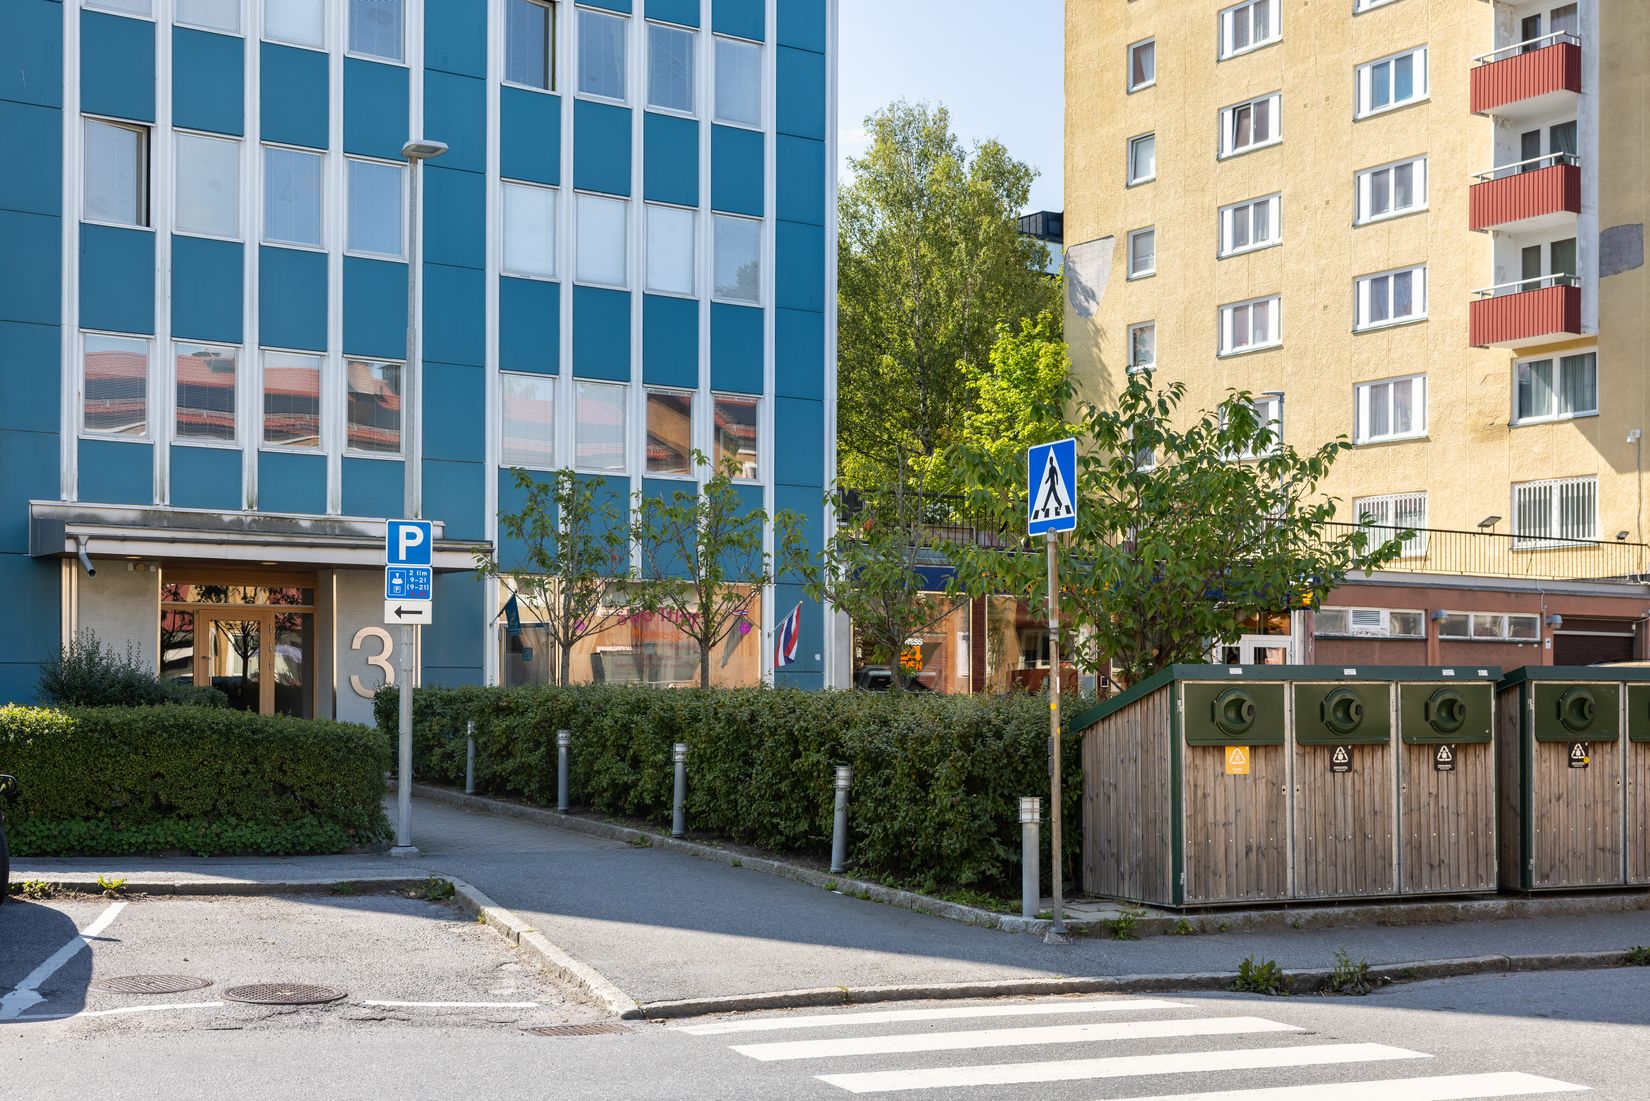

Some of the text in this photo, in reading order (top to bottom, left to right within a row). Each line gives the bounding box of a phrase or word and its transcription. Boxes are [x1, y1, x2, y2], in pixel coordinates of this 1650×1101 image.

[398, 525, 424, 560] P
[406, 583, 429, 591] (9-21)
[350, 626, 395, 699] 3
